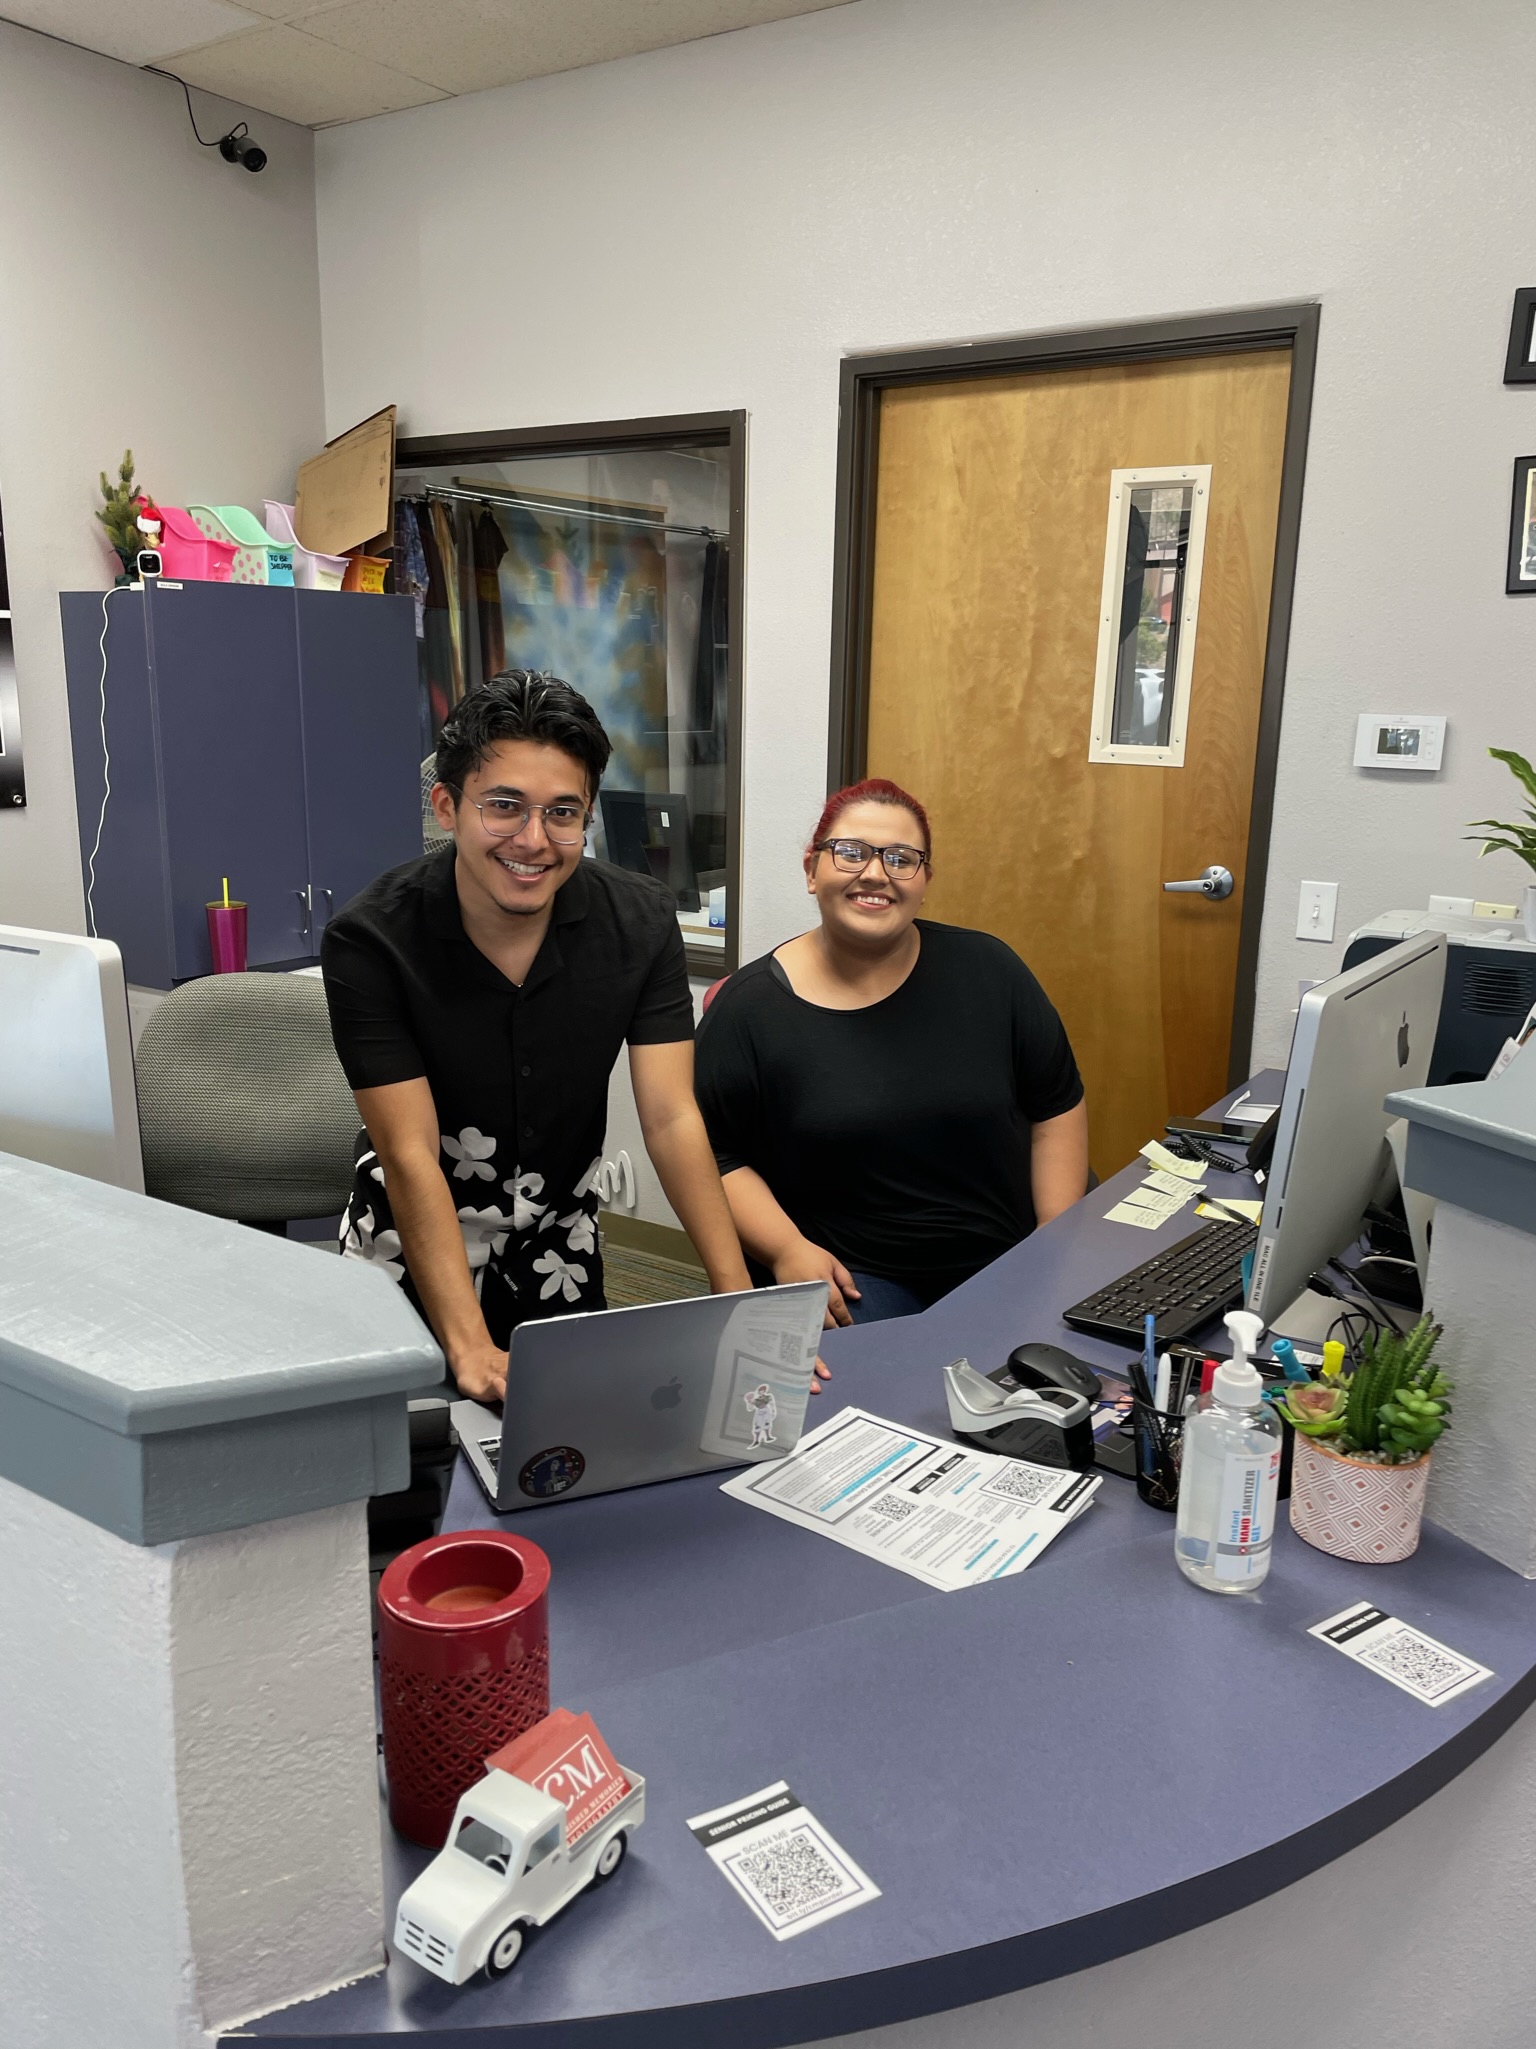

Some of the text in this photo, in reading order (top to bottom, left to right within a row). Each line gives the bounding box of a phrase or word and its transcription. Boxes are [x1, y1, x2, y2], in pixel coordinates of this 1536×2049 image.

[1262, 1244, 1271, 1258] MAC
[1258, 1270, 1264, 1278] IN
[1242, 1470, 1255, 1516] SANITIZER
[1229, 1510, 1240, 1543] Instant
[1239, 1518, 1251, 1543] HAND
[1251, 1526, 1261, 1542] GEL
[544, 1744, 606, 1811] CM
[589, 1776, 624, 1808] MEMORIES
[708, 1797, 790, 1837] SENIOR PRICING GUIDE
[742, 1829, 789, 1855] SCAN ME
